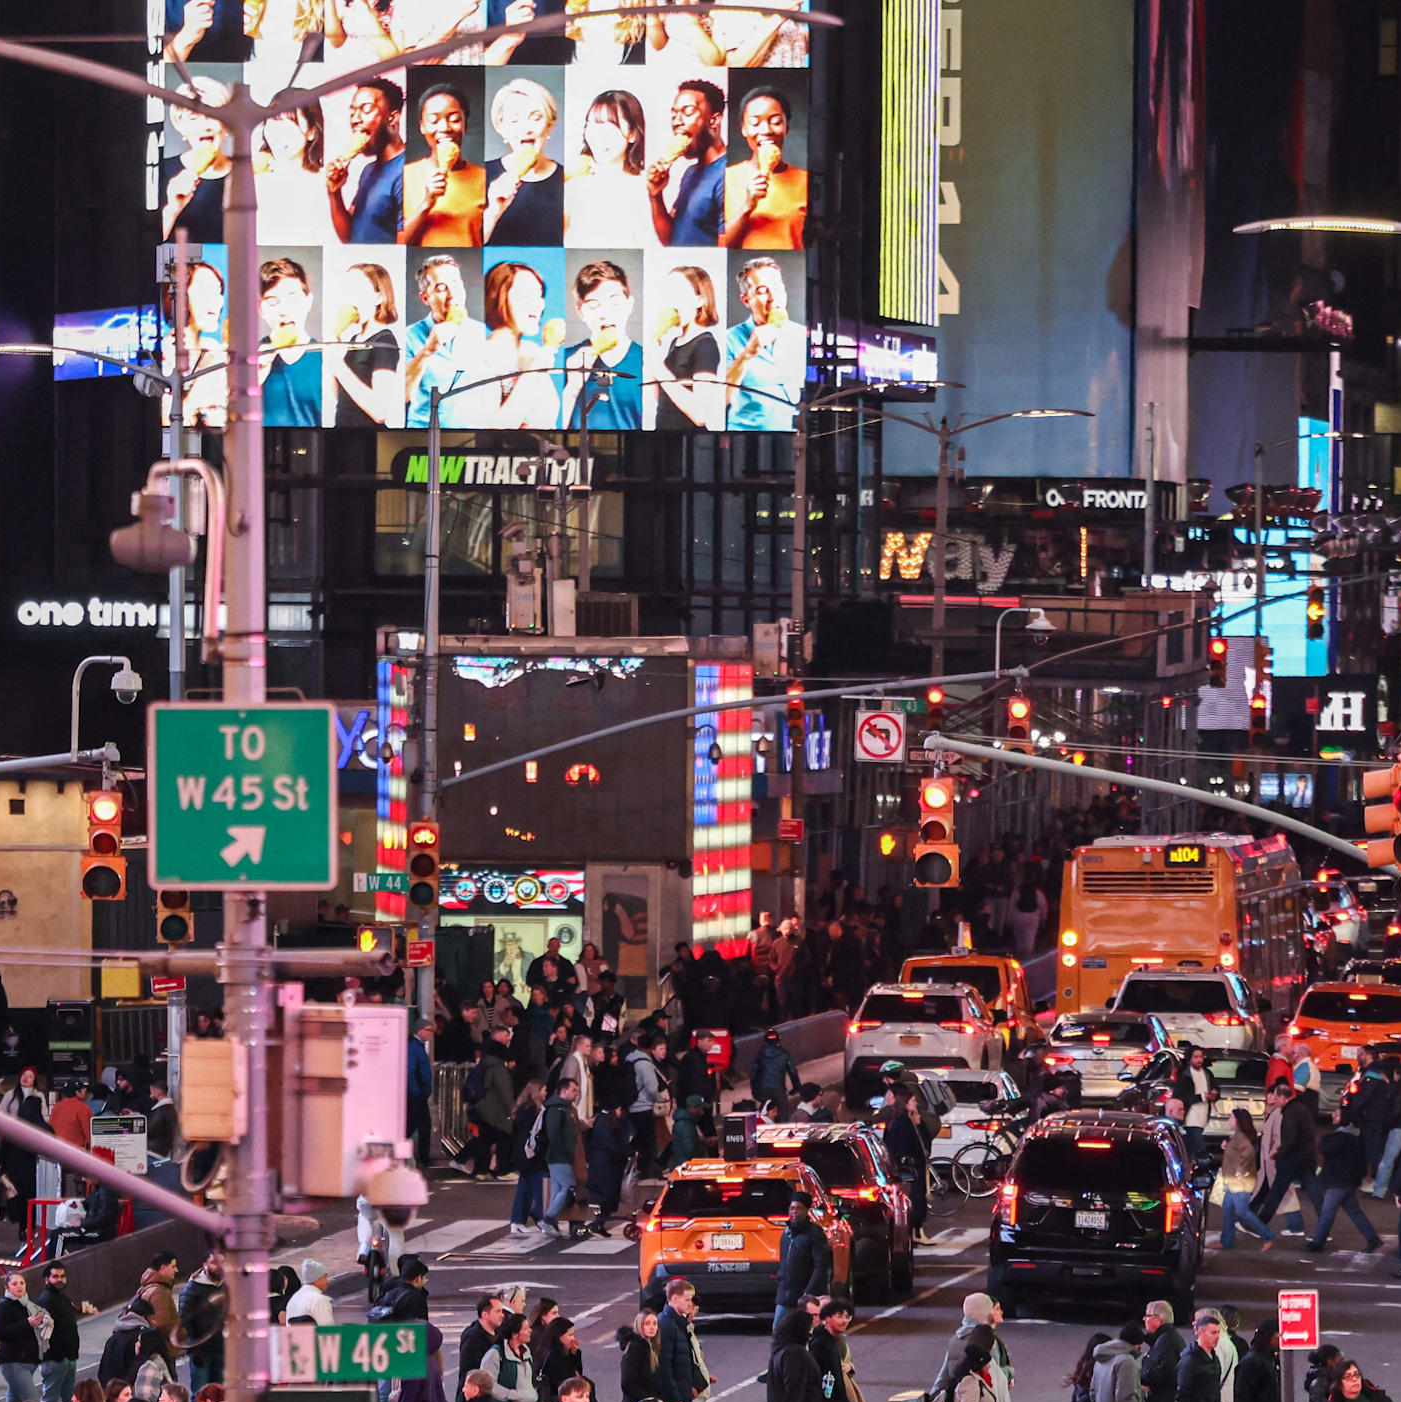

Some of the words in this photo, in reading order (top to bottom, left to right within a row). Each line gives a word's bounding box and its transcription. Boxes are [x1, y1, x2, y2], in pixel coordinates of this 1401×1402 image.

[18, 600, 84, 626] one
[219, 725, 266, 761] TO
[176, 776, 206, 811] W
[212, 776, 264, 811] 45
[273, 774, 310, 811] St
[368, 876, 379, 890] W
[385, 876, 401, 890] 44
[318, 1334, 341, 1373] W
[352, 1333, 390, 1372] 46
[396, 1328, 416, 1353] St
